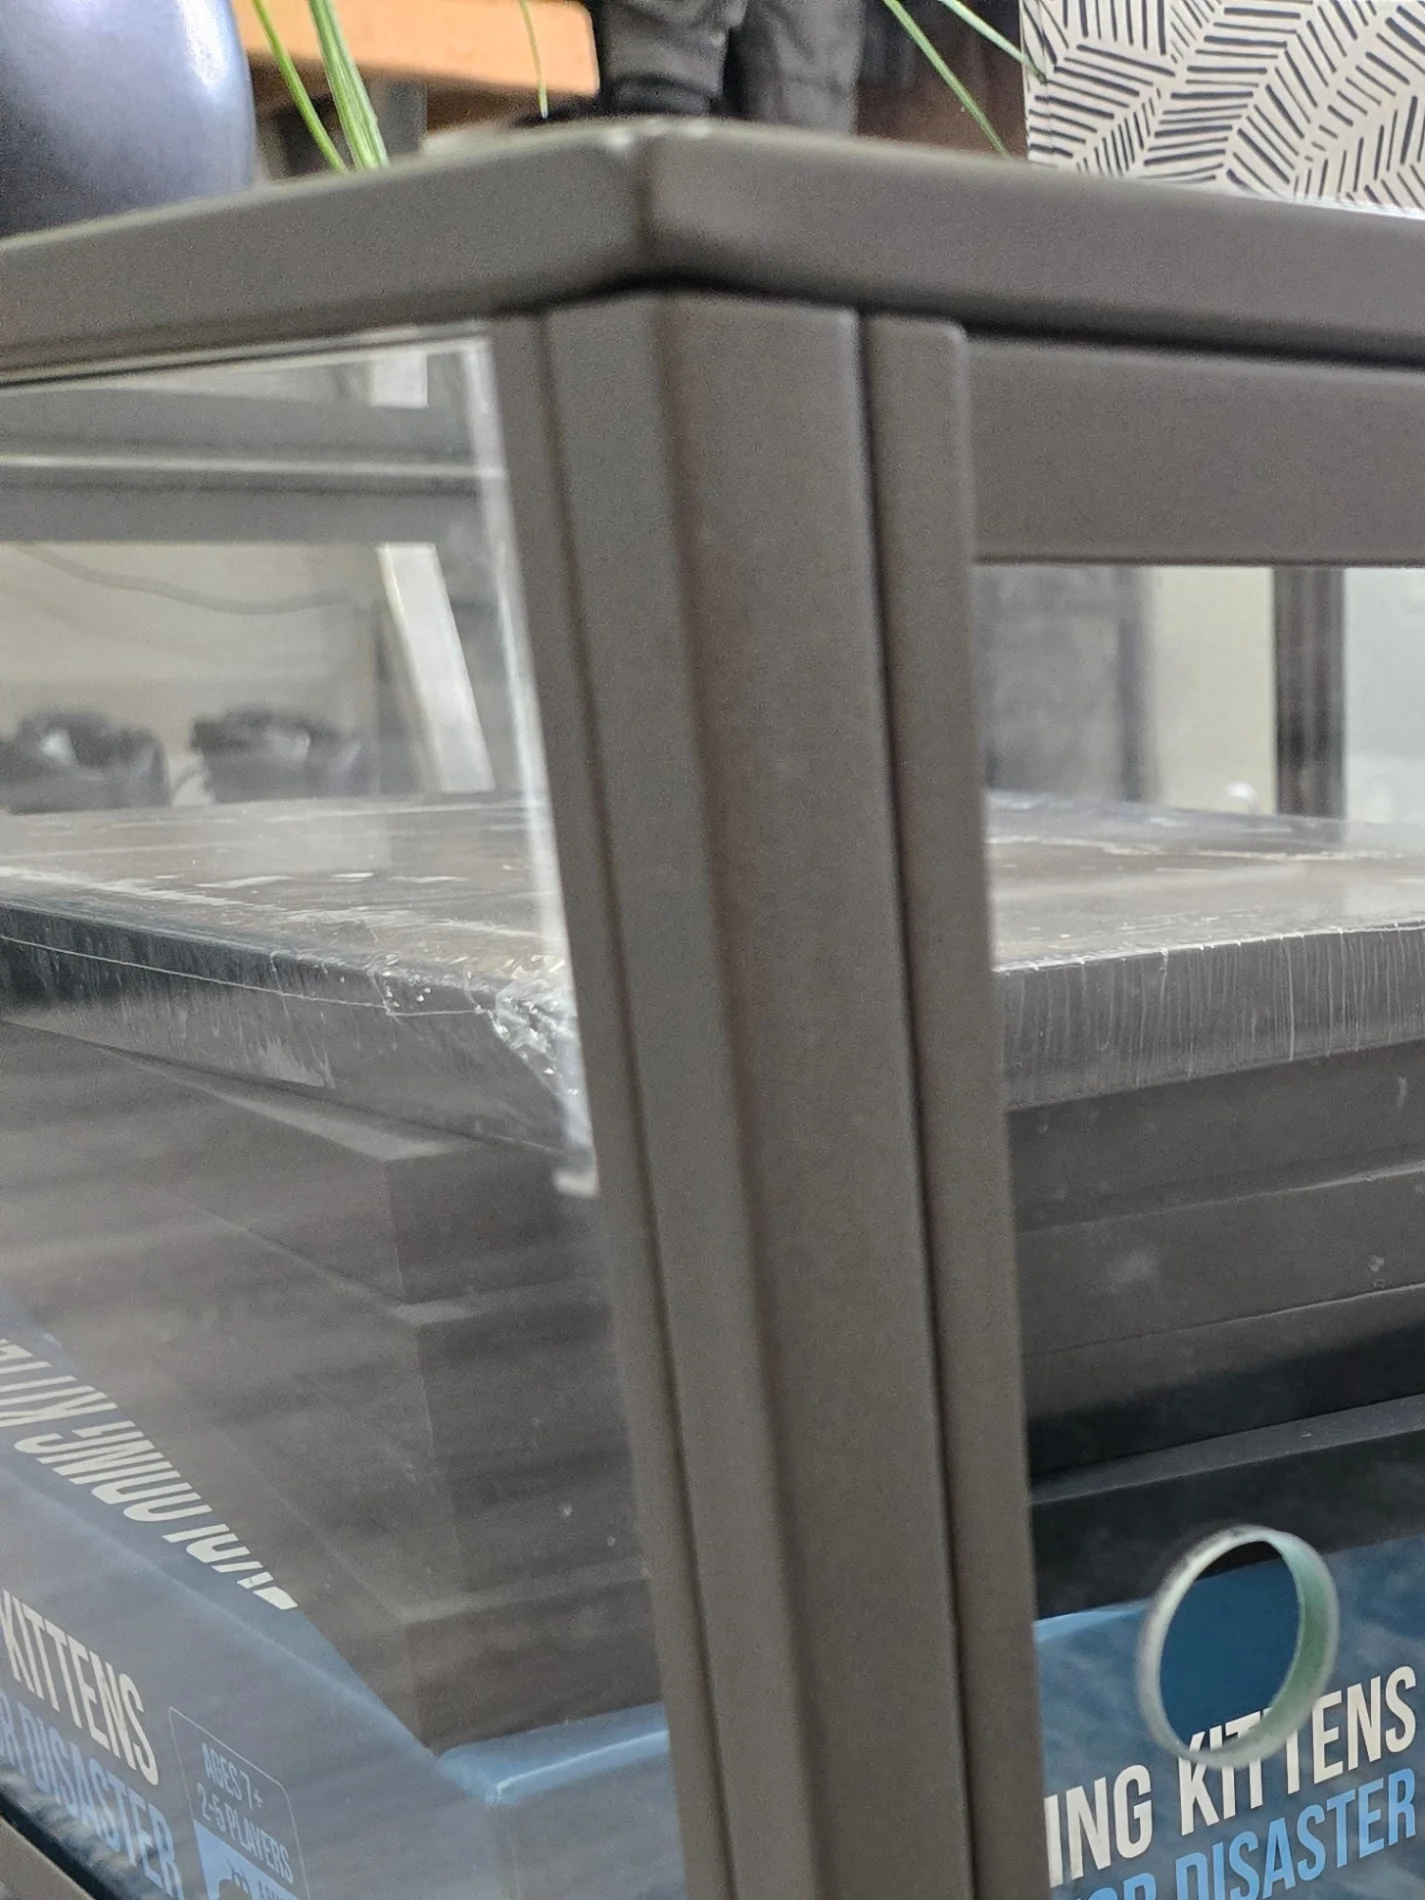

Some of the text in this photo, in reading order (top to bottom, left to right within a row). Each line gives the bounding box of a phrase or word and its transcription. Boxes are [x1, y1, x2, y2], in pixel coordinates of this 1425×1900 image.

[202, 1742, 264, 1811] AGES 7+
[197, 1782, 294, 1885] 2-5 PLAYERS
